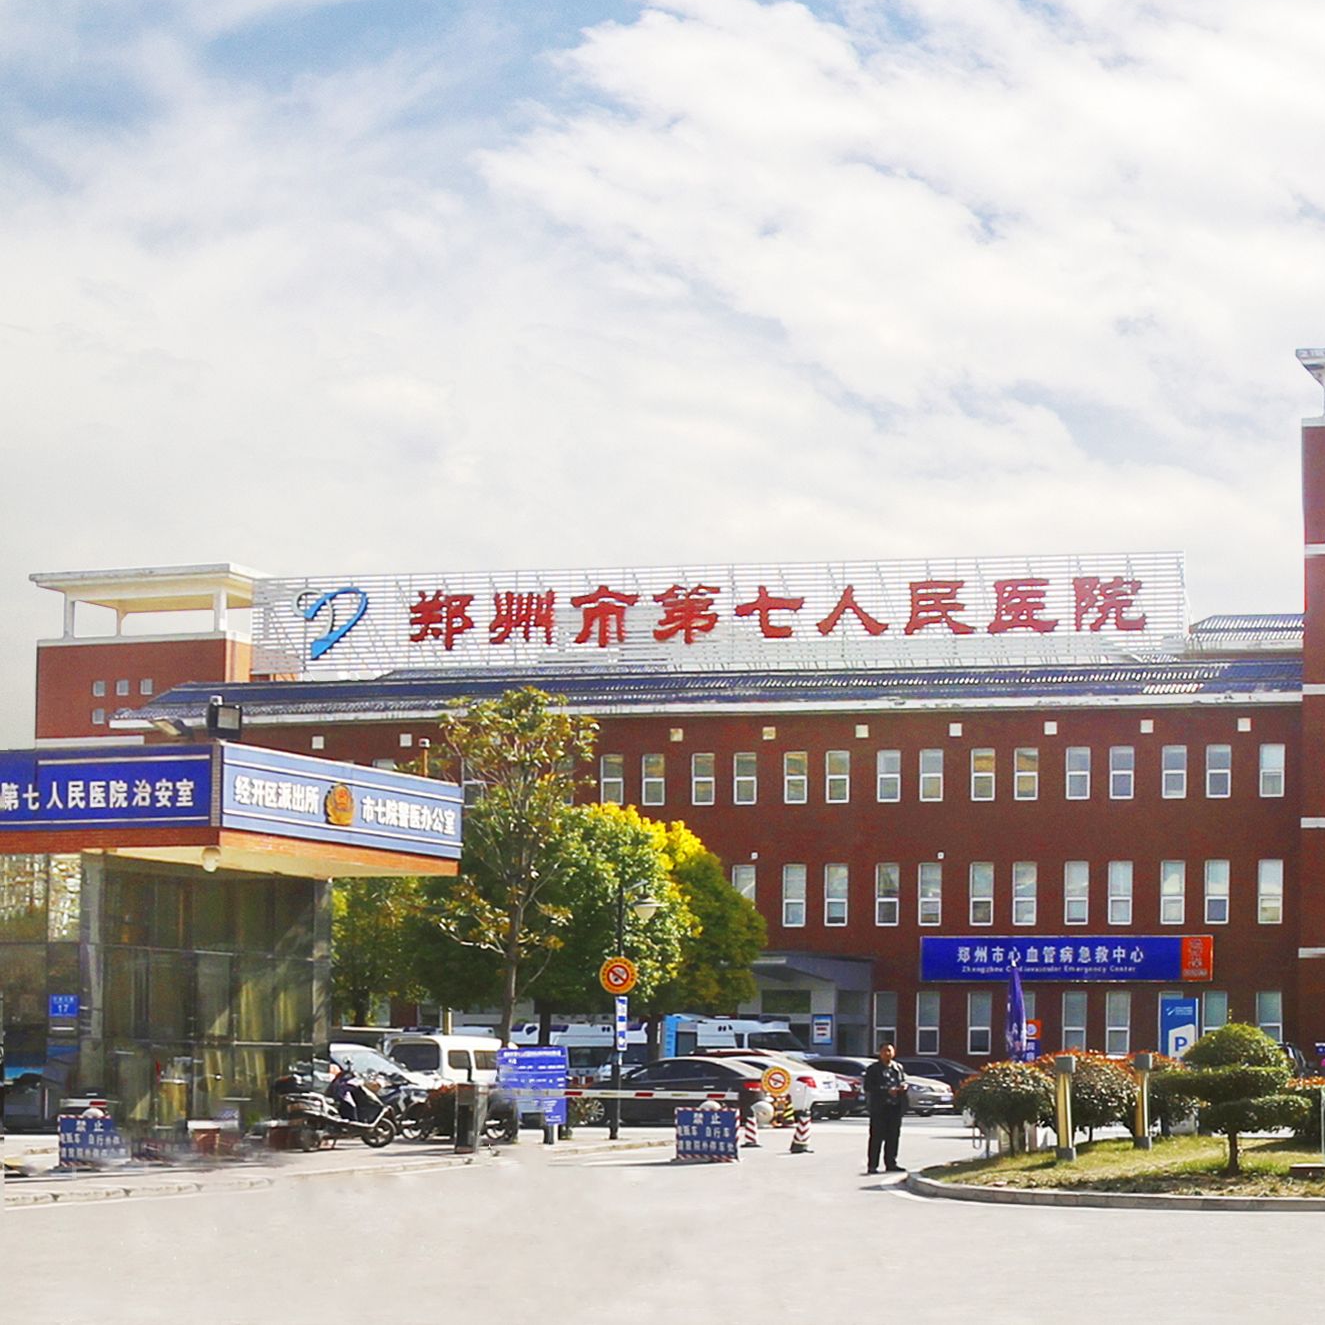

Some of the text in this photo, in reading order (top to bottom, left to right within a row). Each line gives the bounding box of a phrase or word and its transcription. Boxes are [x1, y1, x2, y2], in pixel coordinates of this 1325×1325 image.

[409, 576, 1147, 650] 郑州市第七人民医院
[0, 778, 194, 811] 第七人民医院治安室
[233, 775, 320, 815] 经开区派出所
[957, 945, 1144, 964] 郑州市心血管病急救中心
[1174, 1036, 1188, 1052] P
